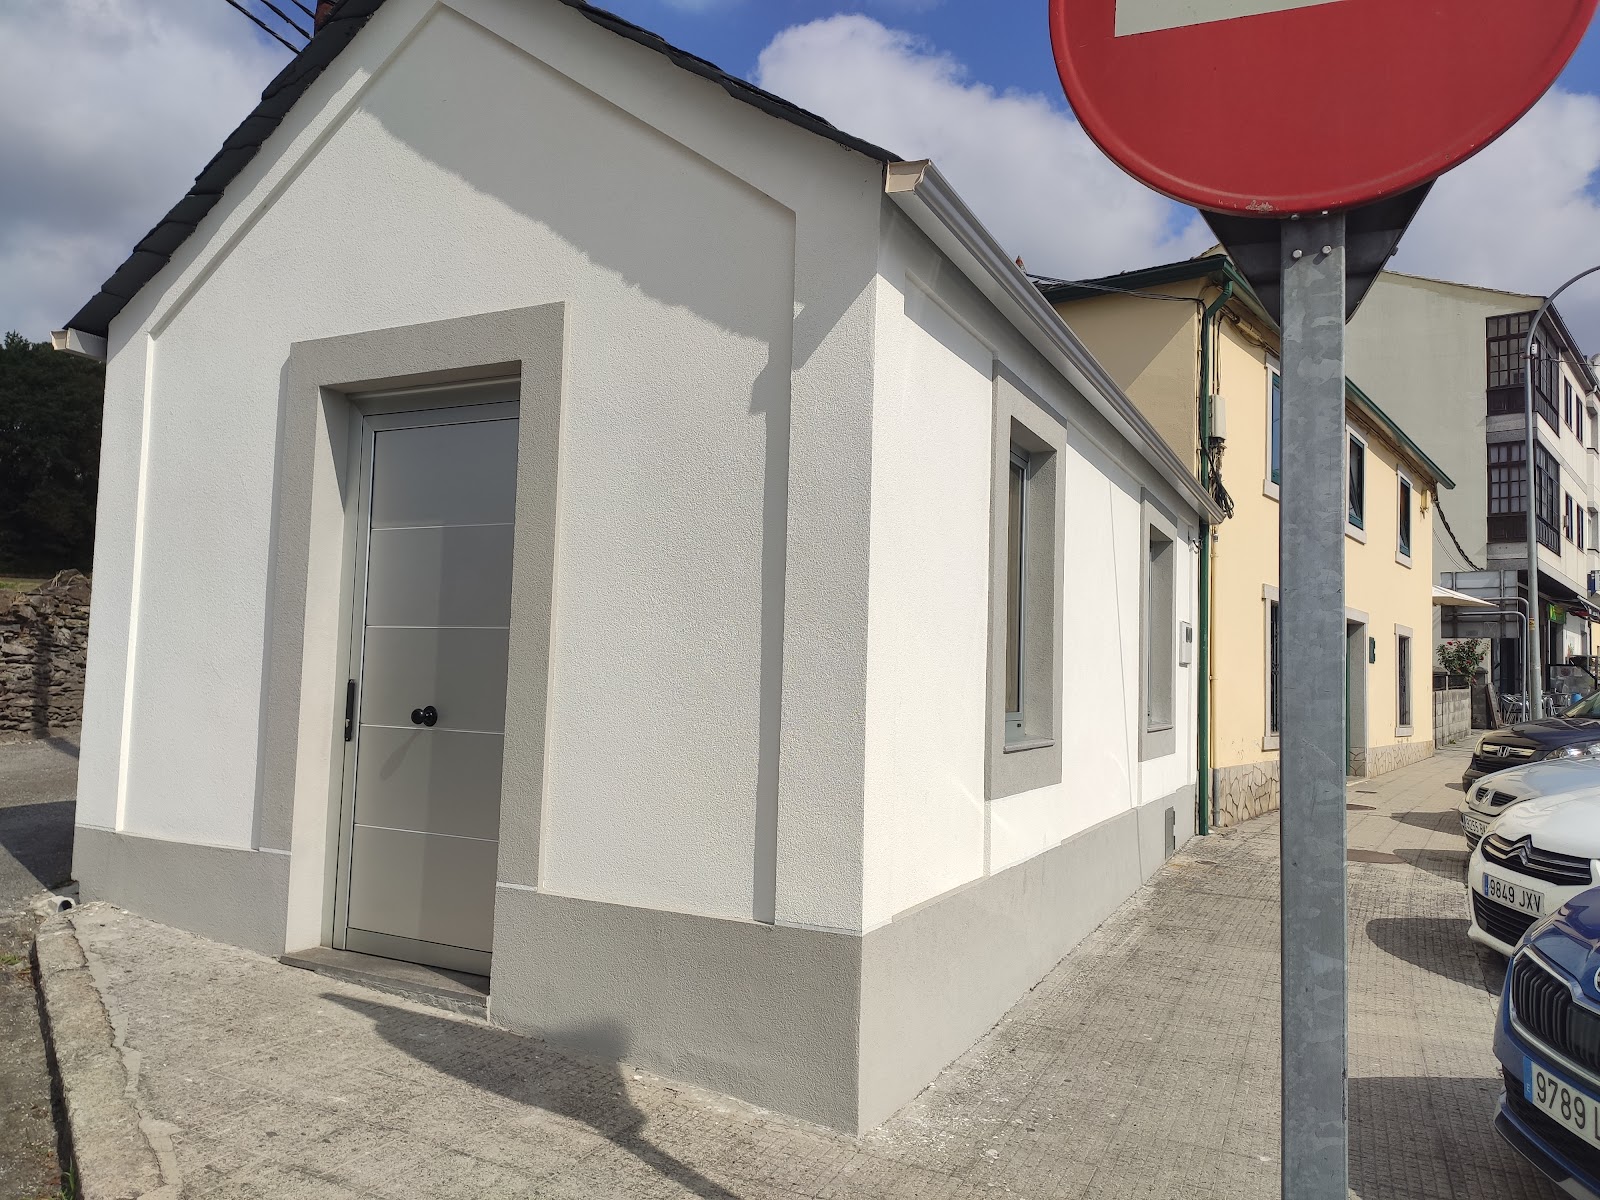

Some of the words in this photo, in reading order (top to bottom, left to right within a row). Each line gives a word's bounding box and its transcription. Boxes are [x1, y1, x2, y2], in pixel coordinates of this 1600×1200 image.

[1490, 879, 1515, 904] 9849
[1519, 890, 1541, 913] JXV
[1536, 1071, 1586, 1130] 9789
